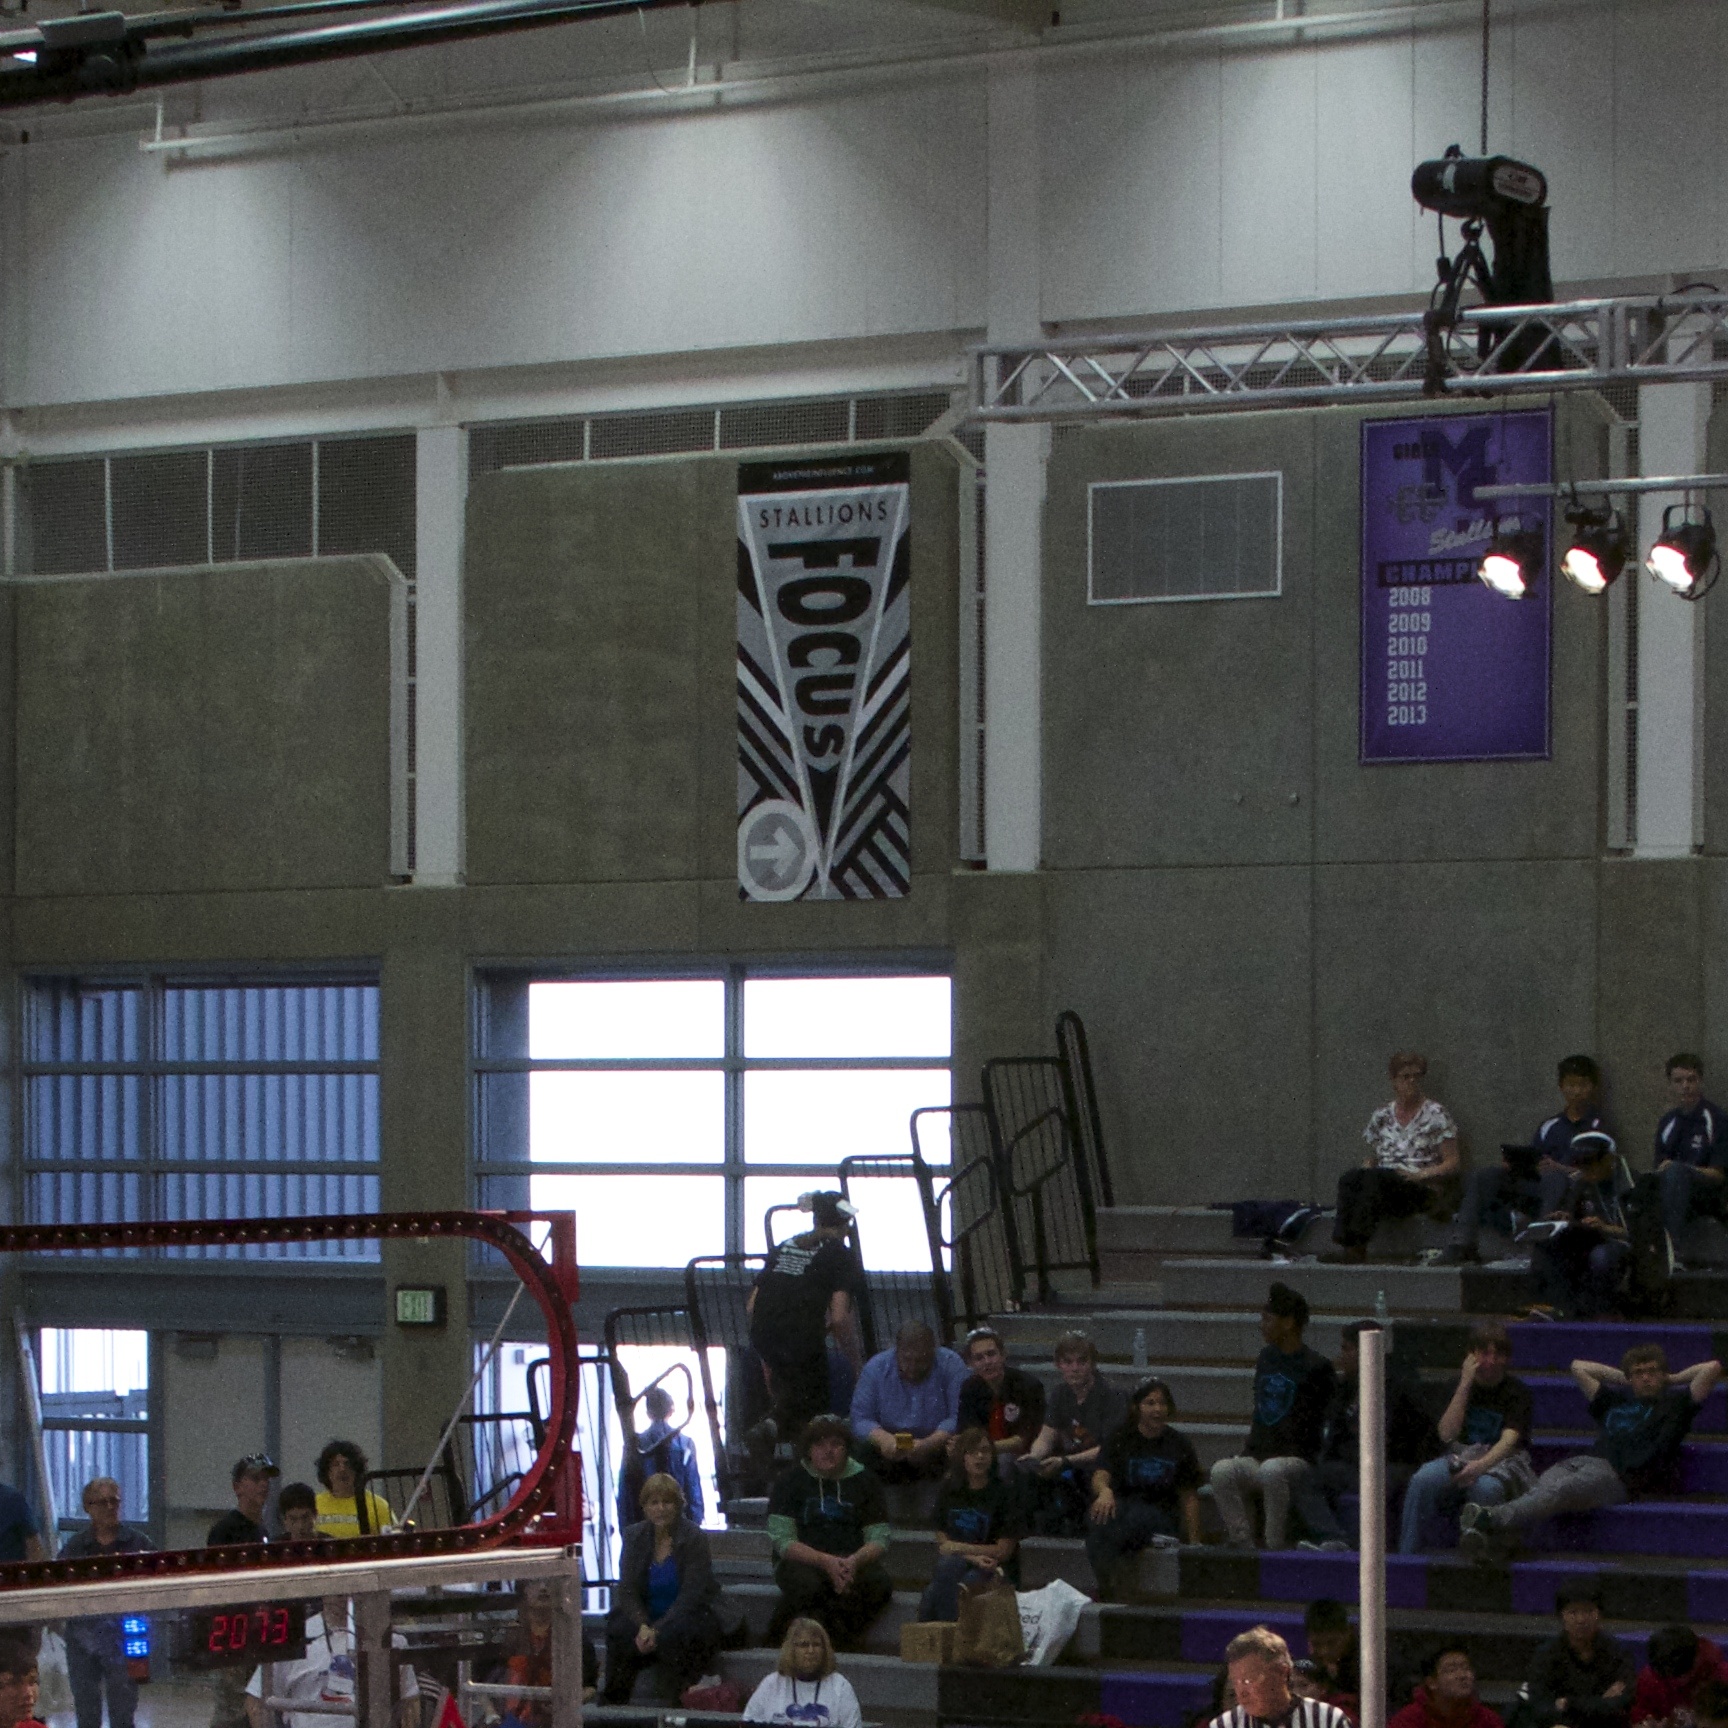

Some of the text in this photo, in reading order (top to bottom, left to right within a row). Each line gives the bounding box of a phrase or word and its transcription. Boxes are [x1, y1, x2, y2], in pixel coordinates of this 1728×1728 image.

[759, 501, 888, 528] STALLIONS
[768, 537, 881, 758] FOCUS
[208, 1608, 289, 1652] 2073
